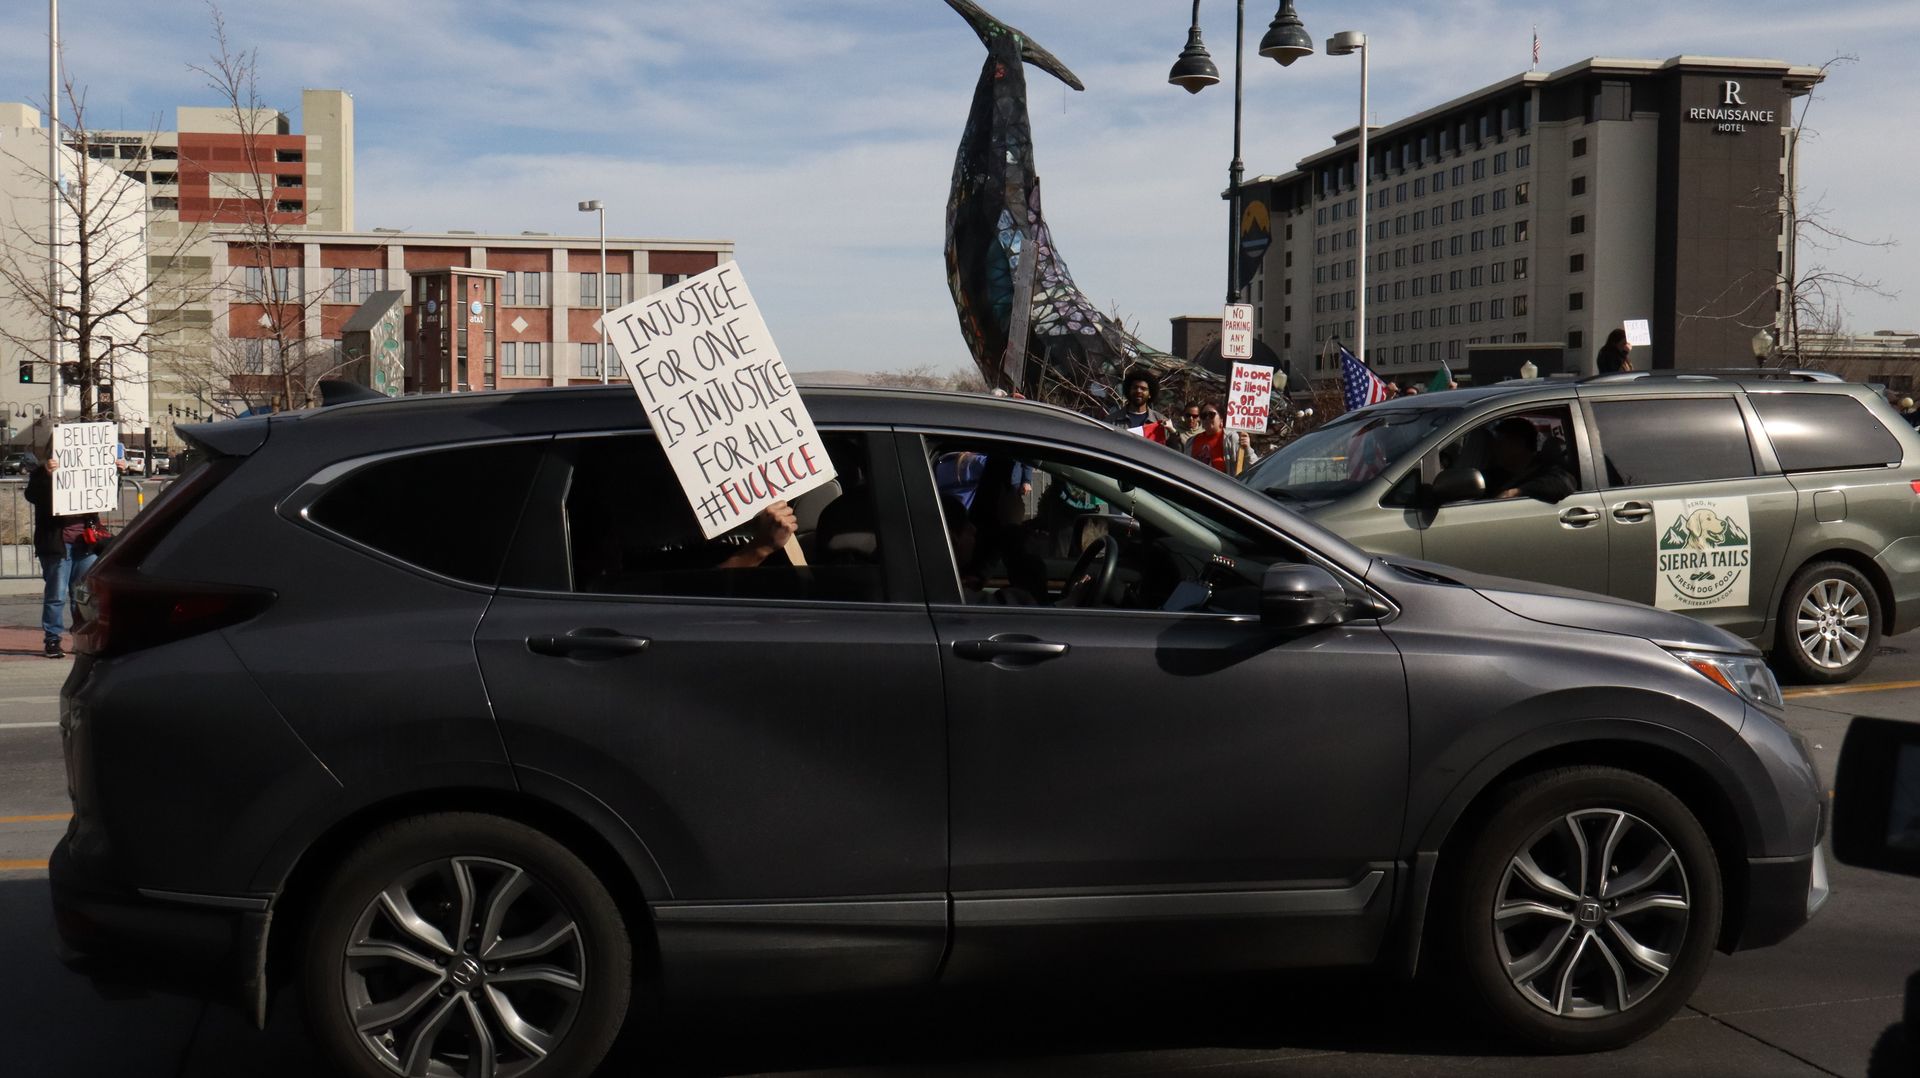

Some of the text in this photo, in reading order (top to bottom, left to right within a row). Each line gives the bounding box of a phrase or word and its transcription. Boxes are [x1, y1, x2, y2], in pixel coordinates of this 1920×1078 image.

[1724, 80, 1747, 105] R
[1690, 108, 1774, 122] RENAISSANCE
[1718, 123, 1746, 132] HOTEL
[617, 268, 747, 354] INJUSTICE
[1232, 308, 1244, 319] NO
[1225, 320, 1251, 332] PARKING
[1229, 344, 1245, 353] TIME
[1230, 334, 1245, 342] ANY
[635, 317, 757, 403] FOR ONE
[1250, 371, 1271, 381] one
[1244, 381, 1270, 396] illegal
[651, 358, 792, 449] IS INJUSTICE
[1227, 400, 1269, 417] STOLEN
[1231, 416, 1264, 429] LAND
[63, 425, 111, 447] BELIEVE
[55, 445, 116, 468] YOUR EYES
[693, 435, 754, 484] FOR
[56, 467, 116, 489] NOT THEIR
[69, 488, 109, 511] LIES!
[1659, 549, 1749, 572] SIERRA TAILS
[1675, 570, 1733, 593] FRESH DOG FOOD
